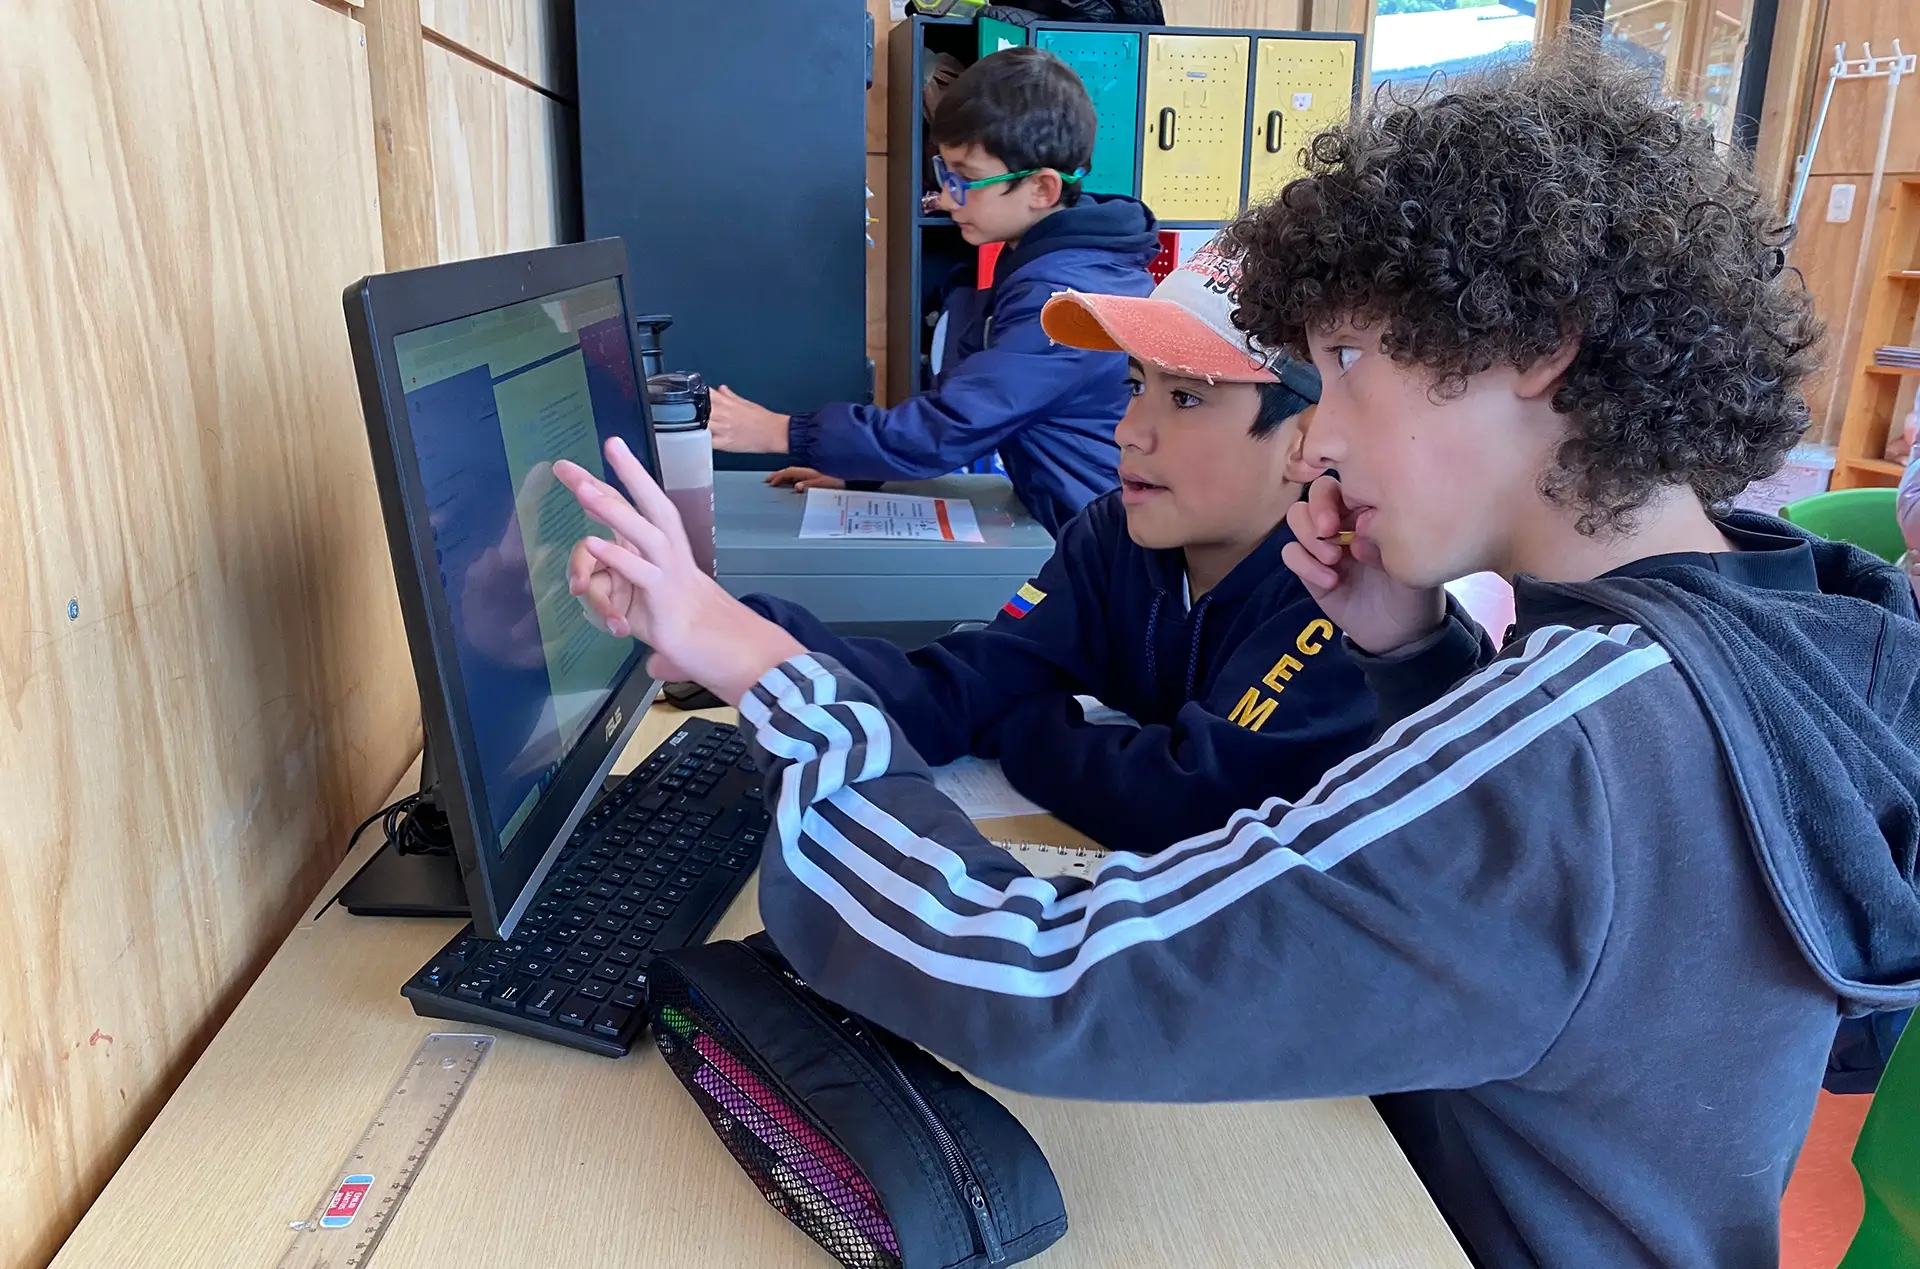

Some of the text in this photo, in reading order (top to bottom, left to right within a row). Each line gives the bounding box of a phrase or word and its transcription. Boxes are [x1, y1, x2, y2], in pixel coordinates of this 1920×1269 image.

[1227, 618, 1334, 732] CEM
[605, 706, 622, 742] ASUS
[669, 730, 688, 746] ASUS
